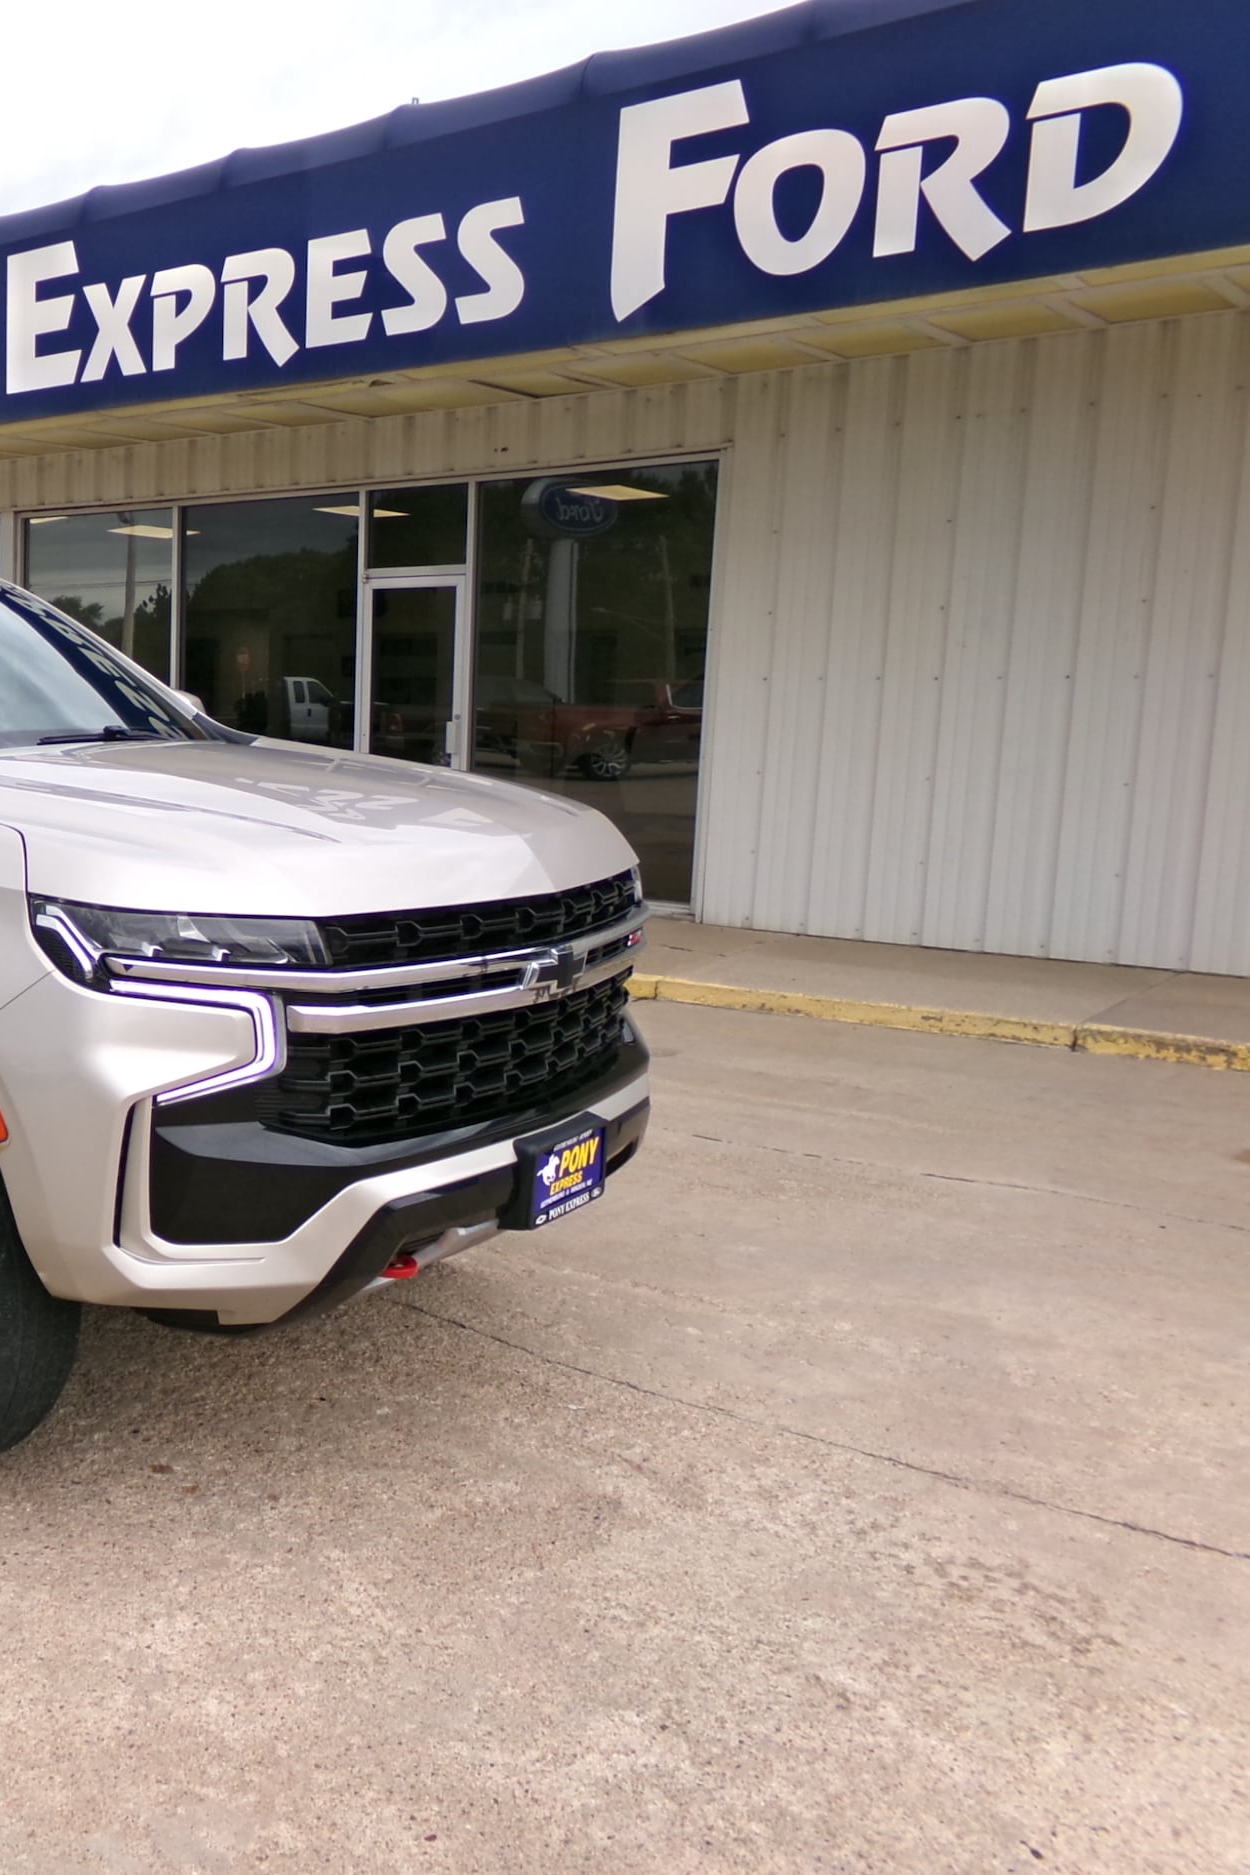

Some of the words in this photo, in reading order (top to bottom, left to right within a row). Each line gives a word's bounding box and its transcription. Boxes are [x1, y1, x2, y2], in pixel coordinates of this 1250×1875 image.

[6, 196, 526, 395] EXPRESS
[610, 62, 1184, 323] FORD
[559, 1136, 600, 1178] PONY
[550, 1170, 583, 1196] EXPRESS
[549, 1203, 566, 1220] PONY
